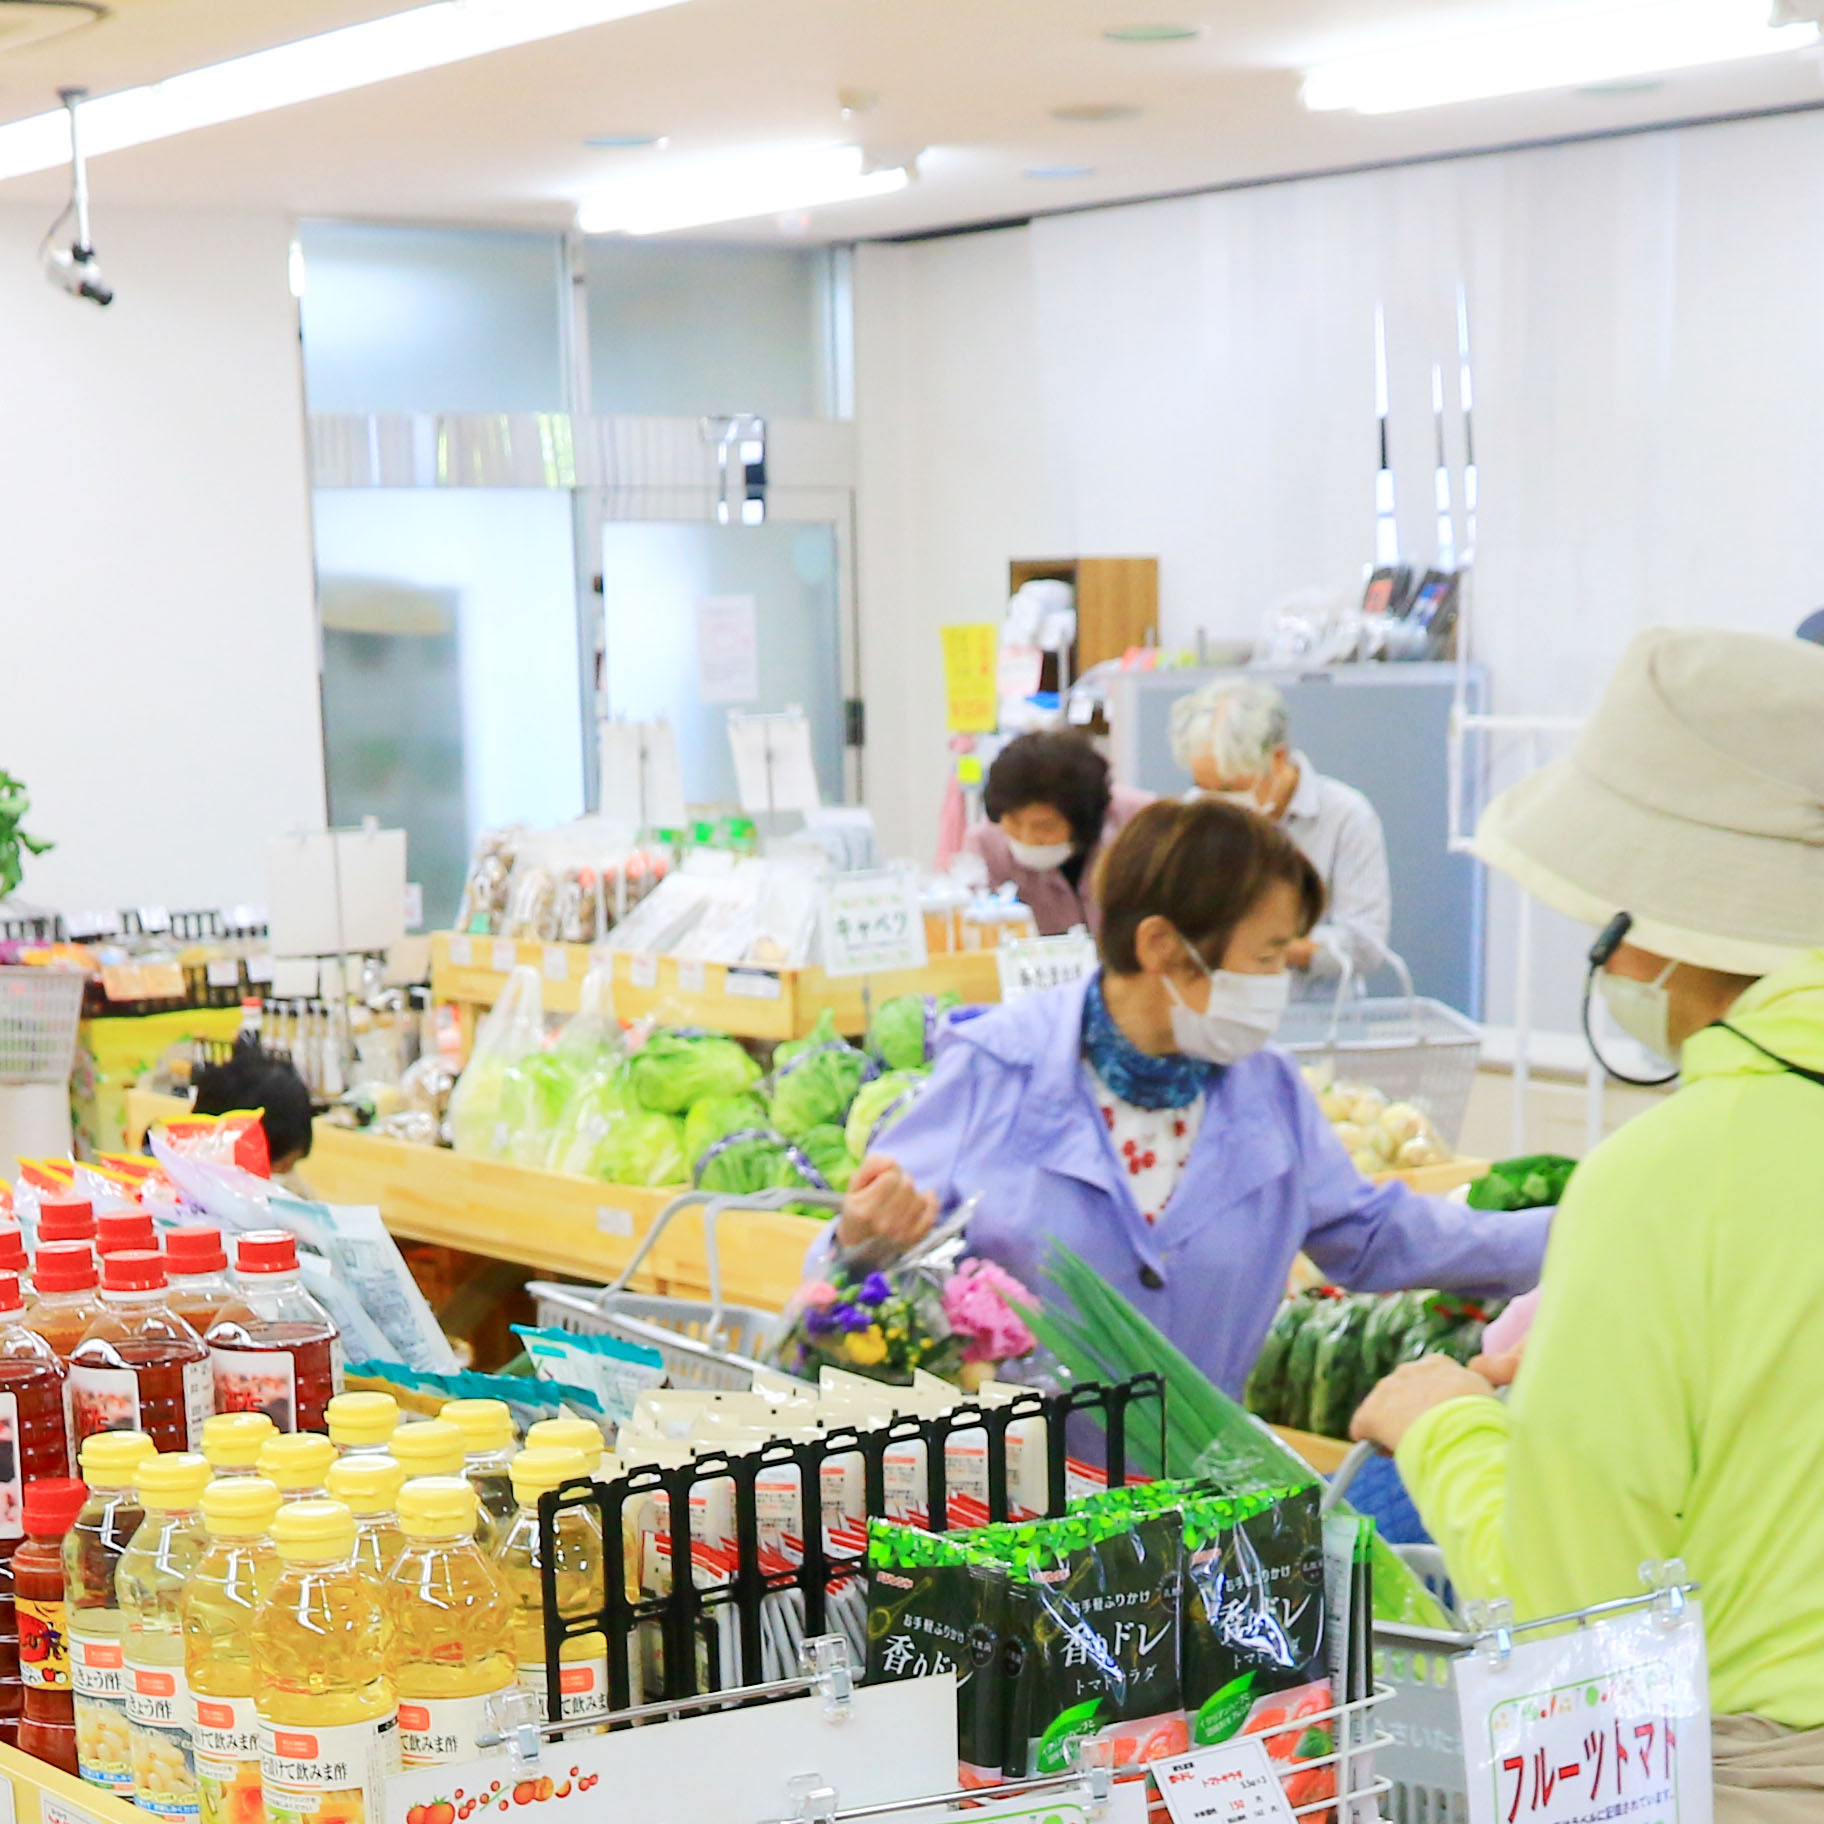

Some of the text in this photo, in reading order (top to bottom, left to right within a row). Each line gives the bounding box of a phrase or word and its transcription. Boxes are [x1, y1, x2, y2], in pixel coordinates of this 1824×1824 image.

[1502, 1704, 1676, 1824] フルーツトマト
